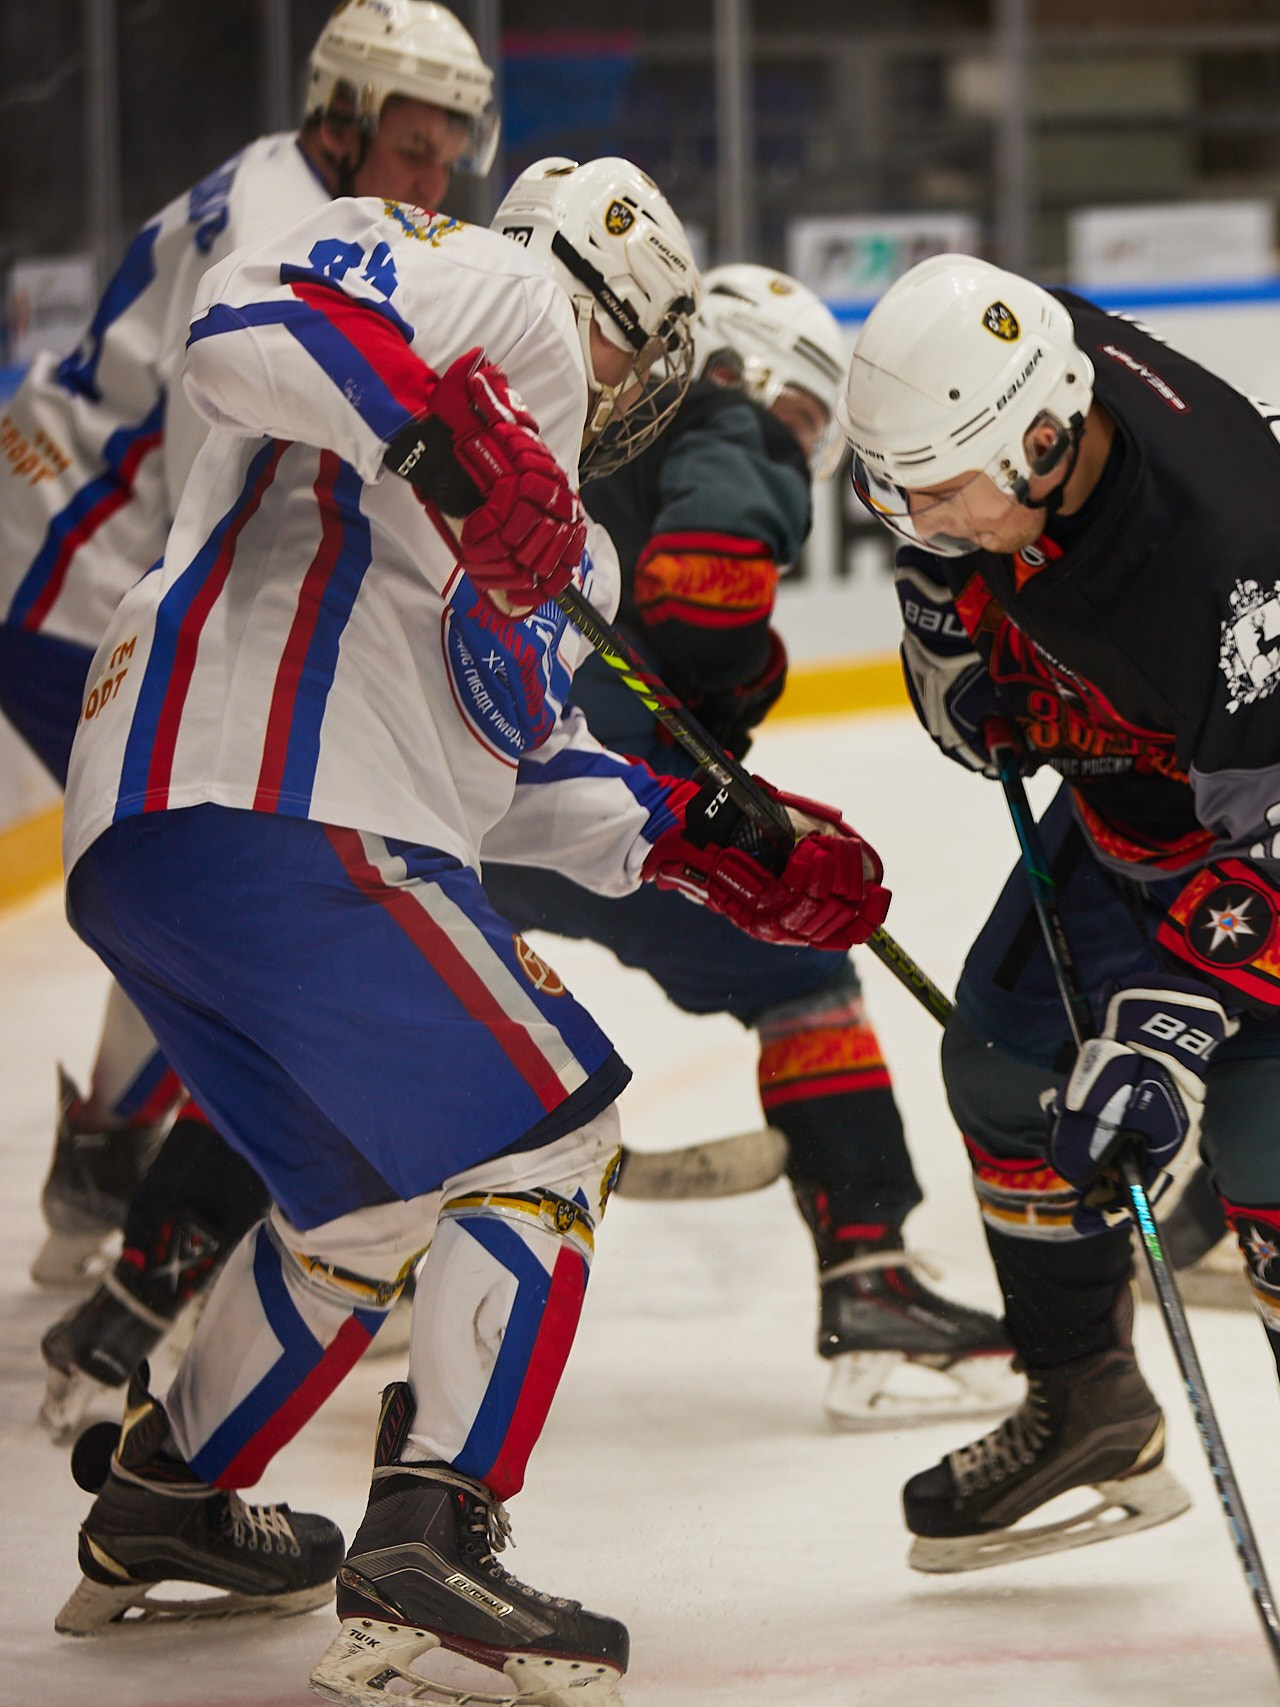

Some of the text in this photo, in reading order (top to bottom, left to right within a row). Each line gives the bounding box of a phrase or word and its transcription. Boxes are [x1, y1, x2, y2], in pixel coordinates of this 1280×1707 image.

[600, 289, 636, 332] BAUER
[995, 346, 1044, 412] BAUER
[397, 438, 427, 476] CCM
[903, 600, 968, 639] BAU
[463, 668, 495, 716] ГИБДД
[704, 787, 729, 819] CC
